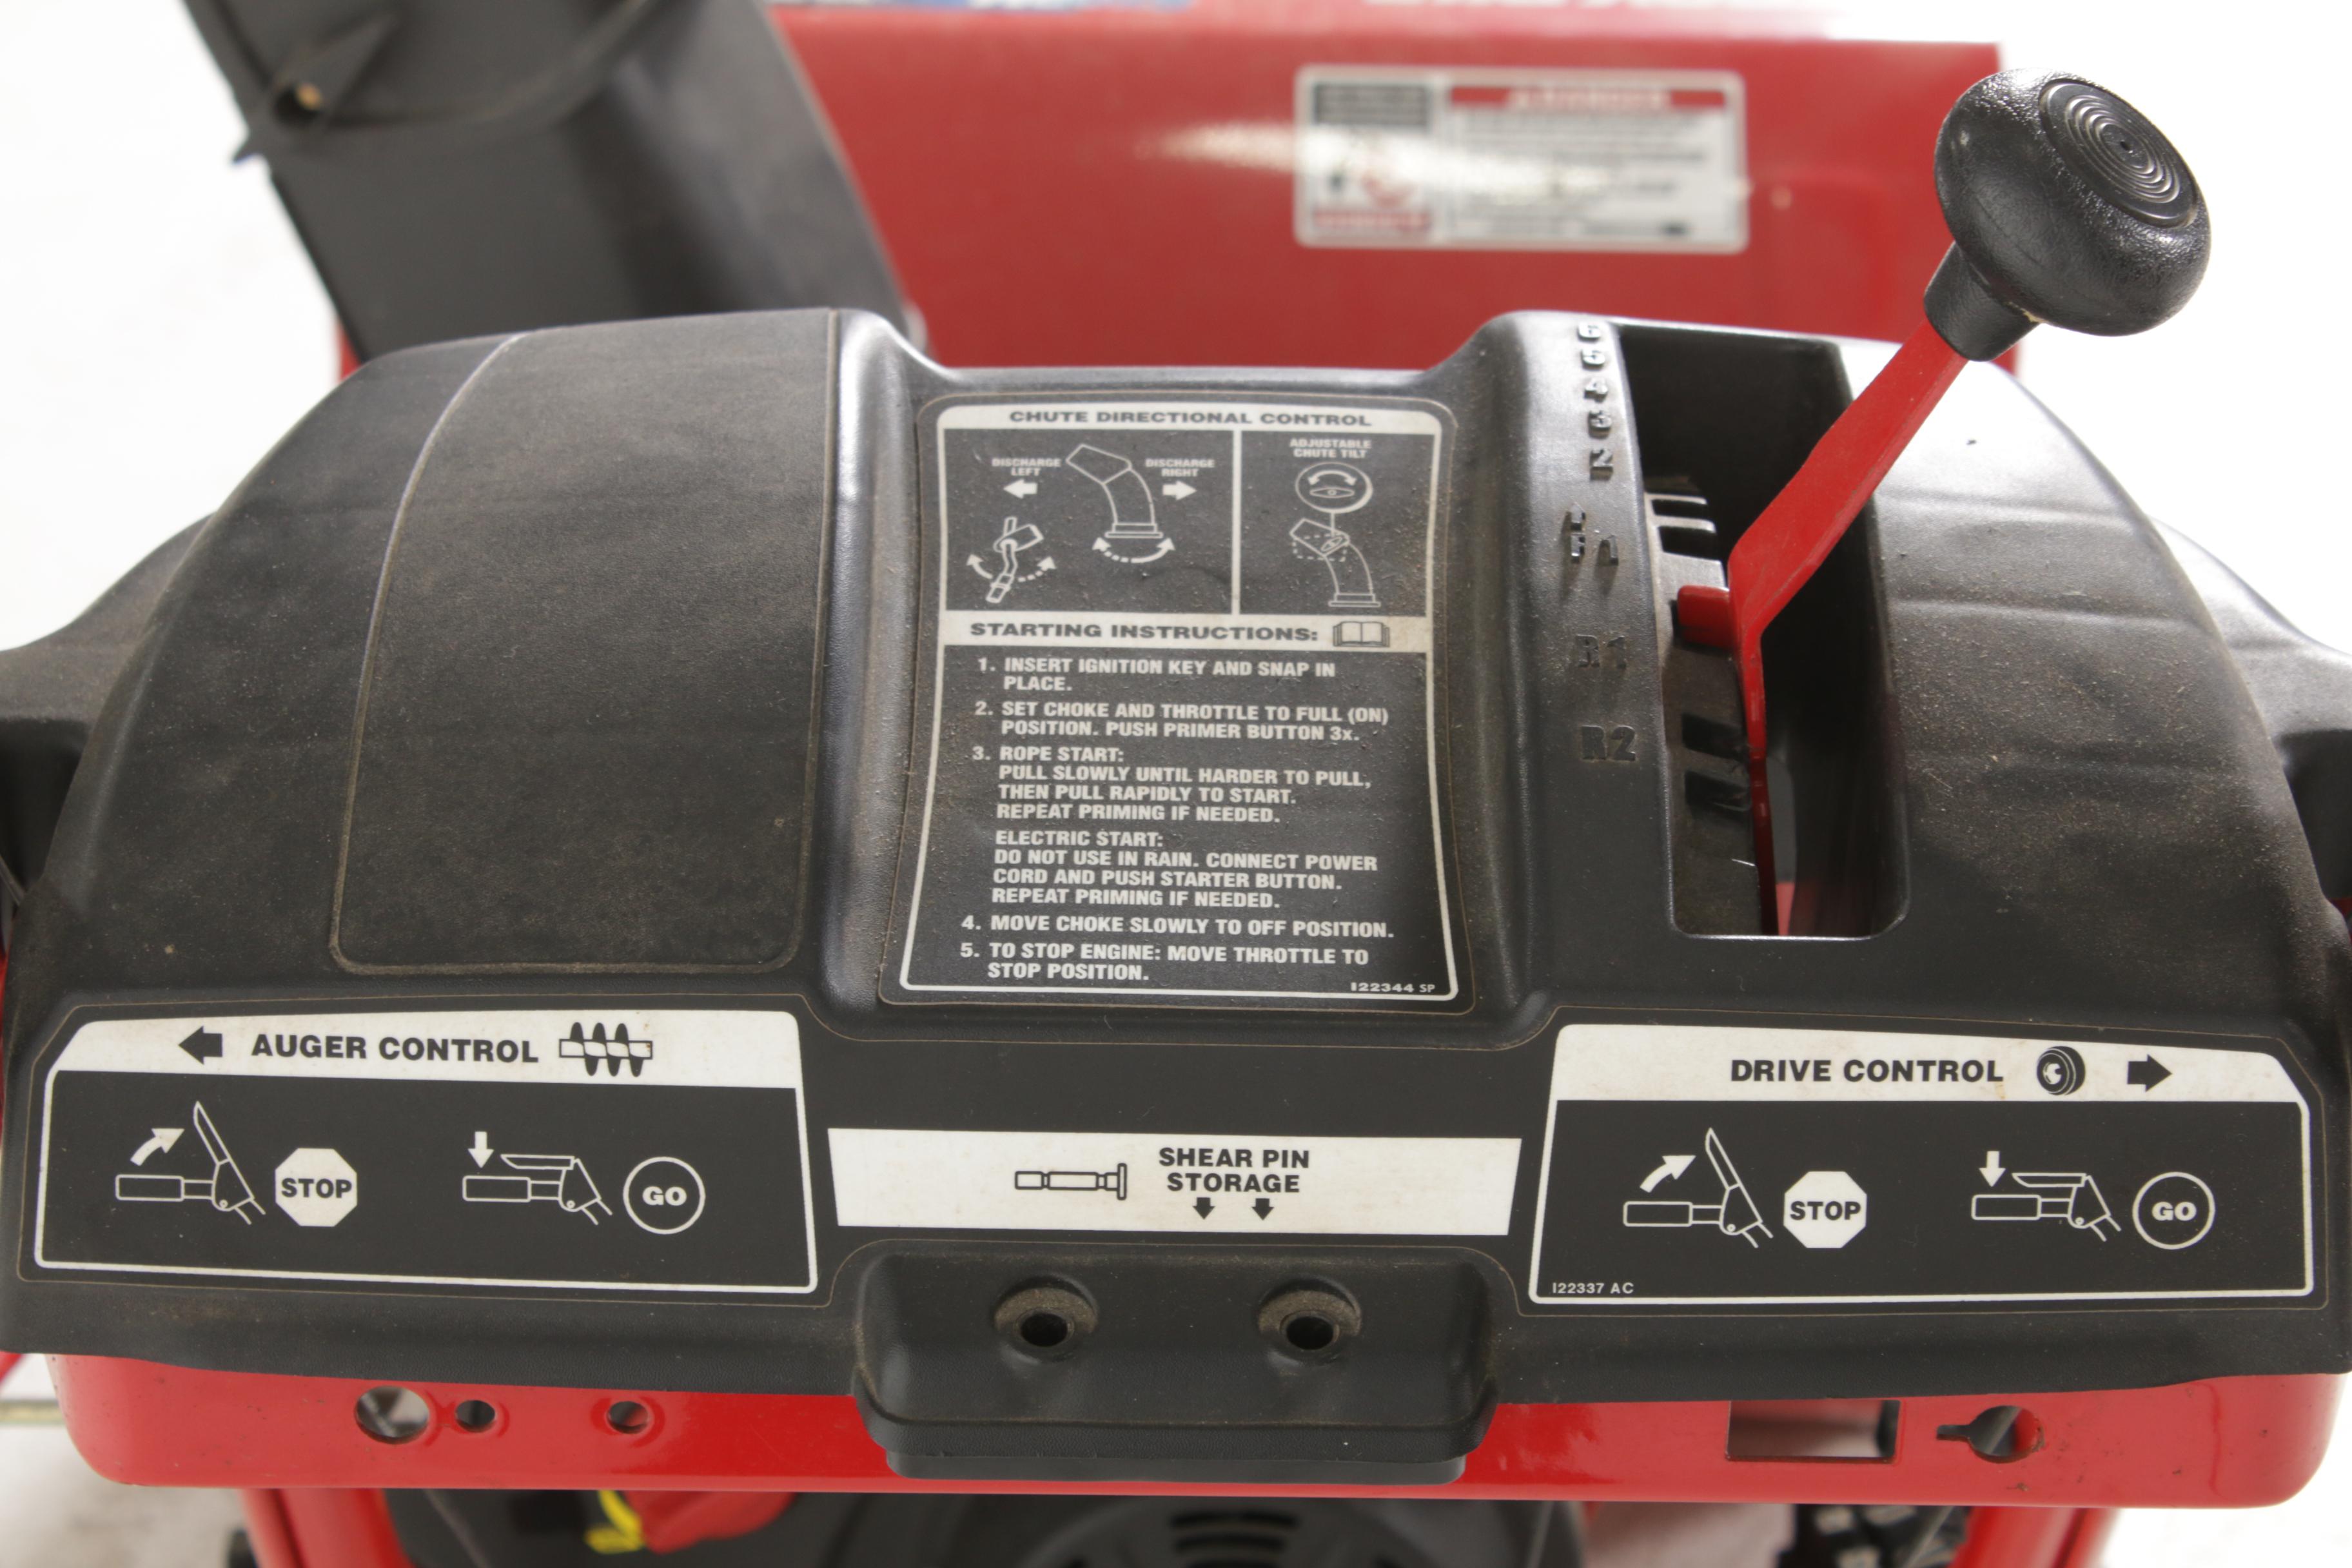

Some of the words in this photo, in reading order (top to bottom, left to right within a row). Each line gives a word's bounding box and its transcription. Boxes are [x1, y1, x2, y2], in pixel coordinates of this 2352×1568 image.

[1009, 411, 1088, 423] CHUTE
[1096, 411, 1252, 424] DIRECTIONAL
[1260, 413, 1371, 427] CONTROL
[1289, 438, 1372, 449] ADJUSTABLE
[1293, 447, 1337, 458] CHUTE
[1340, 449, 1367, 458] TILT
[992, 457, 1062, 467] DISCHARGE
[1011, 467, 1041, 476] LEFT
[1145, 458, 1216, 468] DISCHARGE
[1590, 448, 1613, 476] 2
[1161, 469, 1198, 477] RIGHT
[970, 622, 1102, 638] STARTING
[1111, 624, 1318, 642] INSTRUCTIONS:
[1575, 634, 1626, 668] R1
[977, 657, 996, 672] 1.
[1004, 657, 1073, 672] INSERT
[1078, 658, 1163, 674] IGNITION
[1168, 660, 1207, 675] KEY
[1212, 660, 1253, 676] AND
[1257, 661, 1310, 677] SNAP
[1315, 662, 1335, 677] IN
[1003, 675, 1072, 691] PLACE.
[974, 700, 994, 716] 2.
[1001, 701, 1039, 716] SET
[1043, 701, 1109, 718] CHOKE
[1115, 703, 1155, 718] AND
[1160, 703, 1259, 720] THROTTLE
[1264, 705, 1290, 721] TO
[1296, 706, 1343, 722] FULL
[1347, 707, 1389, 725] (ON)
[1001, 720, 1099, 736] POSITION.
[1105, 720, 1158, 737] PUSH
[1163, 722, 1241, 739] PRIMER
[1246, 724, 1324, 740] BUTTON
[1329, 725, 1360, 741] 3x.
[1581, 725, 1636, 761] R2
[972, 745, 991, 761] 3.
[999, 745, 1052, 761] ROPE
[1057, 746, 1124, 762] START:
[999, 765, 1048, 780] PULL
[1052, 765, 1131, 781] SLOWLY
[1135, 767, 1193, 783] UNTIL
[1199, 768, 1278, 784] HARDER
[1283, 769, 1309, 785] TO
[1315, 770, 1371, 789] PULL,
[998, 783, 1050, 799] THEN
[1055, 784, 1104, 800] PULL
[1109, 785, 1192, 801] RAPIDLY
[1198, 787, 1224, 803] TO
[1229, 787, 1296, 804] START.
[996, 803, 1073, 819] REPEAT
[1078, 804, 1165, 821] PRIMING
[1171, 805, 1190, 821] IF
[1195, 806, 1280, 823] NEEDED.
[995, 830, 1090, 847] ELECTRIC
[1096, 830, 1163, 847] START:
[994, 848, 1022, 865] DO
[1028, 849, 1068, 865] NOT
[1073, 850, 1112, 866] USE
[1117, 850, 1138, 866] IN
[1144, 851, 1199, 867] RAIN.
[1206, 852, 1299, 869] CONNECT
[1305, 854, 1378, 871] POWER
[993, 868, 1048, 884] CORD
[1054, 868, 1095, 885] AND
[1101, 870, 1155, 886] PUSH
[1160, 870, 1250, 888] STARTER
[1255, 872, 1342, 890] BUTTON.
[992, 887, 1070, 904] REPEAT
[1075, 888, 1163, 906] PRIMING
[1169, 890, 1189, 906] IF
[1194, 891, 1280, 908] NEEDED.
[961, 915, 981, 930] 4.
[990, 915, 1050, 931] MOVE
[1056, 915, 1124, 932] CHOKE
[1129, 917, 1209, 934] SLOWLY
[1215, 919, 1242, 935] TO
[1248, 919, 1287, 936] OFF
[1292, 920, 1394, 938] POSITION.
[960, 942, 980, 958] 5.
[989, 942, 1016, 959] TO
[1021, 943, 1075, 959] STOP
[1080, 943, 1161, 961] ENGINE:
[1167, 945, 1227, 962] MOVE
[1233, 946, 1336, 964] THROTTLE
[1341, 948, 1369, 965] TO
[988, 962, 1041, 979] STOP
[1047, 963, 1149, 981] POSITION.
[1419, 984, 1435, 993] SP
[251, 1034, 367, 1059] AUGER
[378, 1037, 539, 1063] CONTROL
[1731, 1059, 1832, 1082] DRIVE
[1843, 1059, 2004, 1083] CONTROL
[1159, 1147, 1253, 1168] SHEAR
[1262, 1149, 1309, 1169] PIN
[281, 1177, 353, 1199] STOP
[1167, 1172, 1300, 1193] STORAGE
[642, 1186, 687, 1206] GO
[1790, 1200, 1861, 1221] STOP
[2151, 1201, 2197, 1221] GO
[1610, 1282, 1634, 1294] AC
